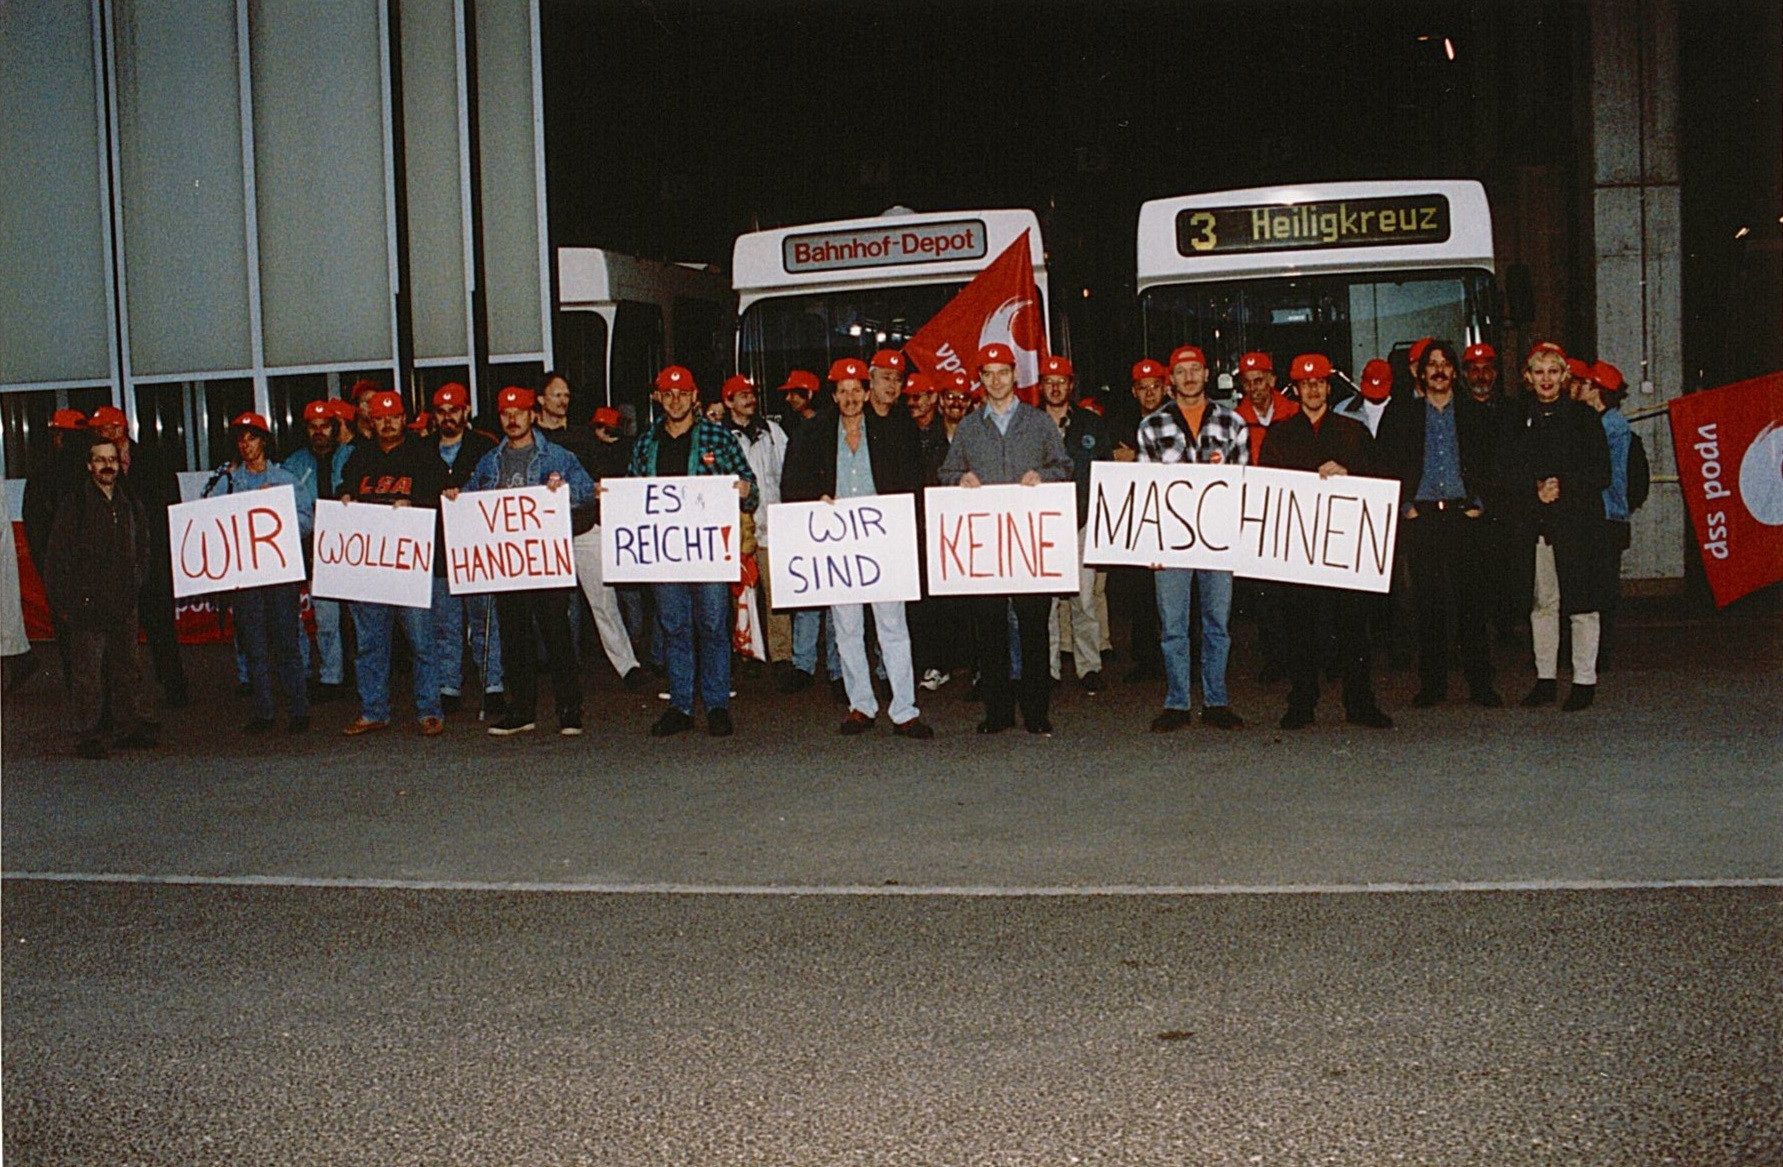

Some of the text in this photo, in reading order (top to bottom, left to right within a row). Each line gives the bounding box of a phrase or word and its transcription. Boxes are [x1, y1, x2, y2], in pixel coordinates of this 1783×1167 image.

[794, 229, 975, 264] Bahnhof-Depot
[1190, 204, 1438, 251] 3 Heiligkreuz
[645, 484, 682, 515] ES
[1694, 423, 1731, 559] vpod ssp
[478, 496, 556, 533] VER-
[809, 507, 886, 543] WIR
[1094, 480, 1391, 575] MASCHINEN
[181, 508, 286, 580] WIR
[318, 530, 431, 572] WOLLEN
[451, 539, 572, 585] HANDELN
[615, 524, 732, 567] REICHT!
[940, 511, 1063, 580] KEINE
[788, 555, 881, 594] SIND
